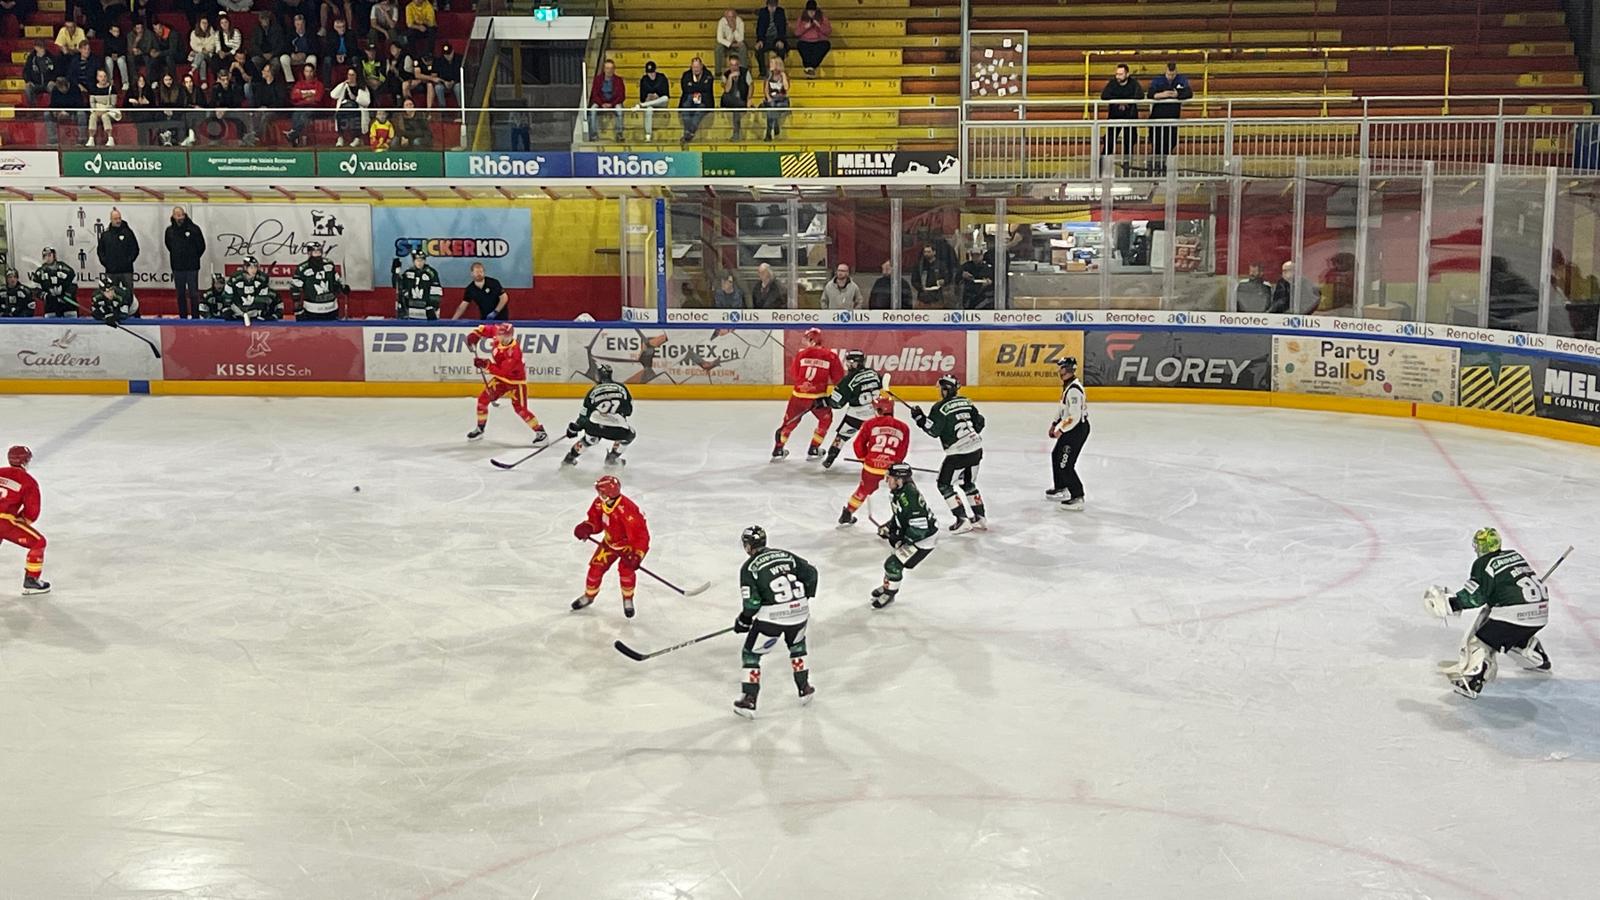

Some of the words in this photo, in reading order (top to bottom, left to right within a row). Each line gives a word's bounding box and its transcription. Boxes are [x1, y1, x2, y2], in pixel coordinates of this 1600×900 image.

[104, 157, 162, 170] vaudoise
[359, 157, 417, 171] vaudoise
[837, 153, 896, 168] MELLY
[395, 238, 510, 257] STICKERKID
[668, 311, 709, 321] enotec
[772, 311, 820, 322] Renotec
[882, 311, 930, 323] Renotec
[994, 311, 1042, 323] Renotec
[1106, 312, 1156, 323] Renotec
[1219, 314, 1269, 326] Renotec
[1333, 319, 1383, 332] Renotec
[1446, 327, 1495, 342] Renotec
[17, 350, 100, 367] Taillens
[996, 343, 1065, 368] BITZ
[1321, 340, 1380, 366] Party
[216, 362, 312, 377] KISSKISS.ch
[433, 365, 472, 375] L'ENVIE
[1117, 356, 1252, 385] FLOREY
[870, 434, 900, 456] 22
